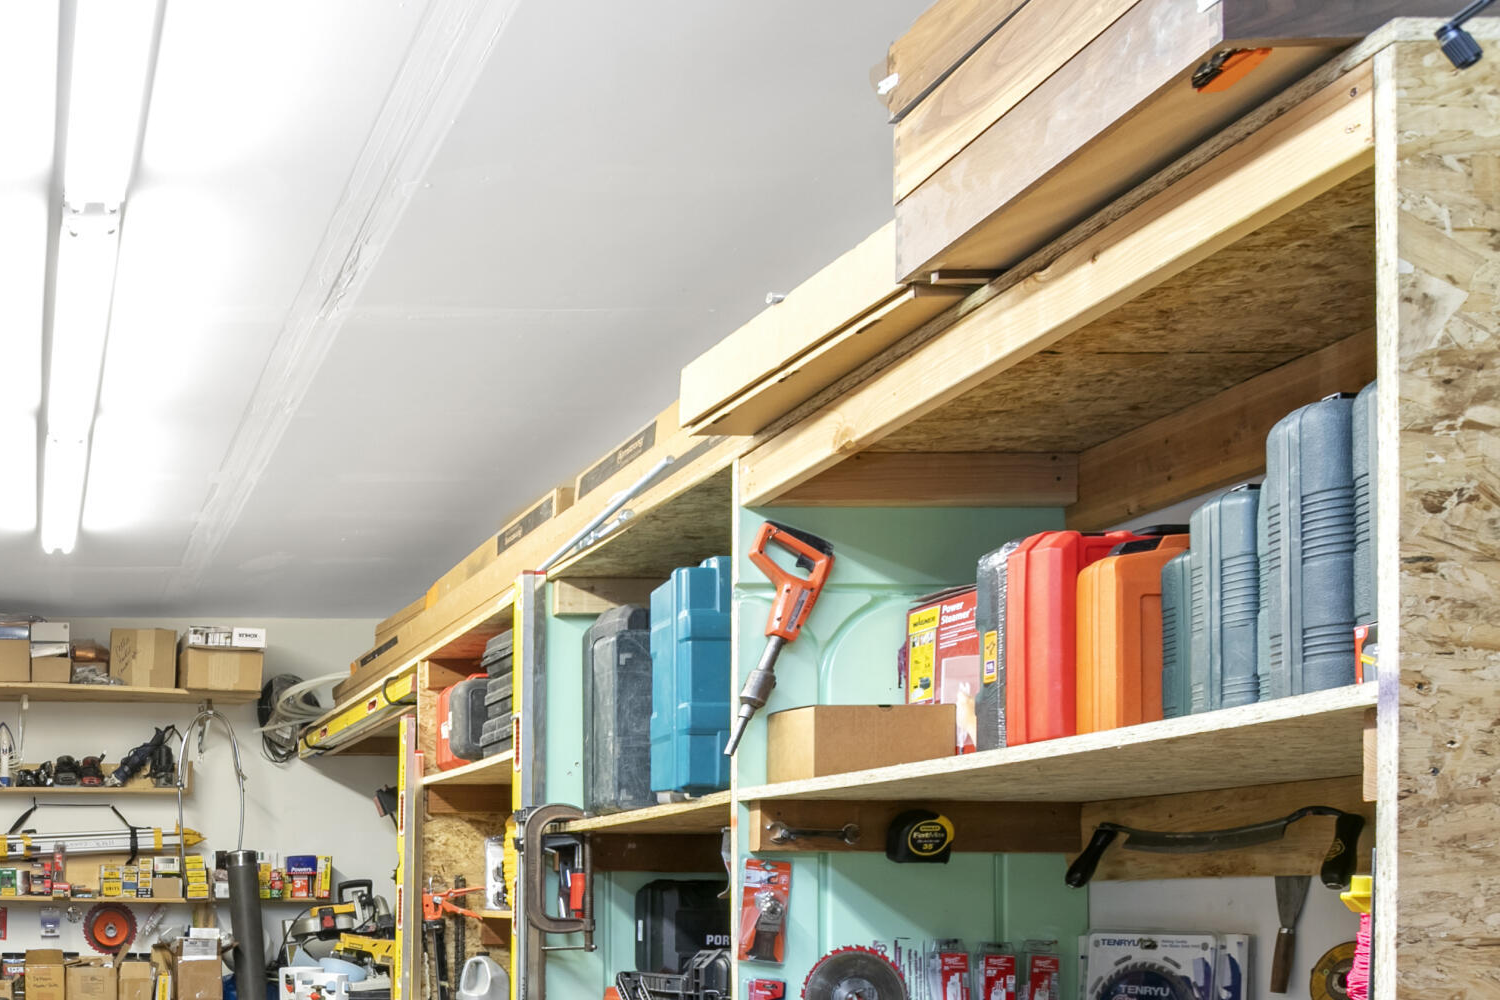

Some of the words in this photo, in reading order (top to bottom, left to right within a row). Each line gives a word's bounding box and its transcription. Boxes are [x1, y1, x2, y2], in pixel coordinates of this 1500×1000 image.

[941, 601, 965, 615] Power
[1101, 938, 1141, 949] TENRYU
[1120, 984, 1171, 998] TENRYU
